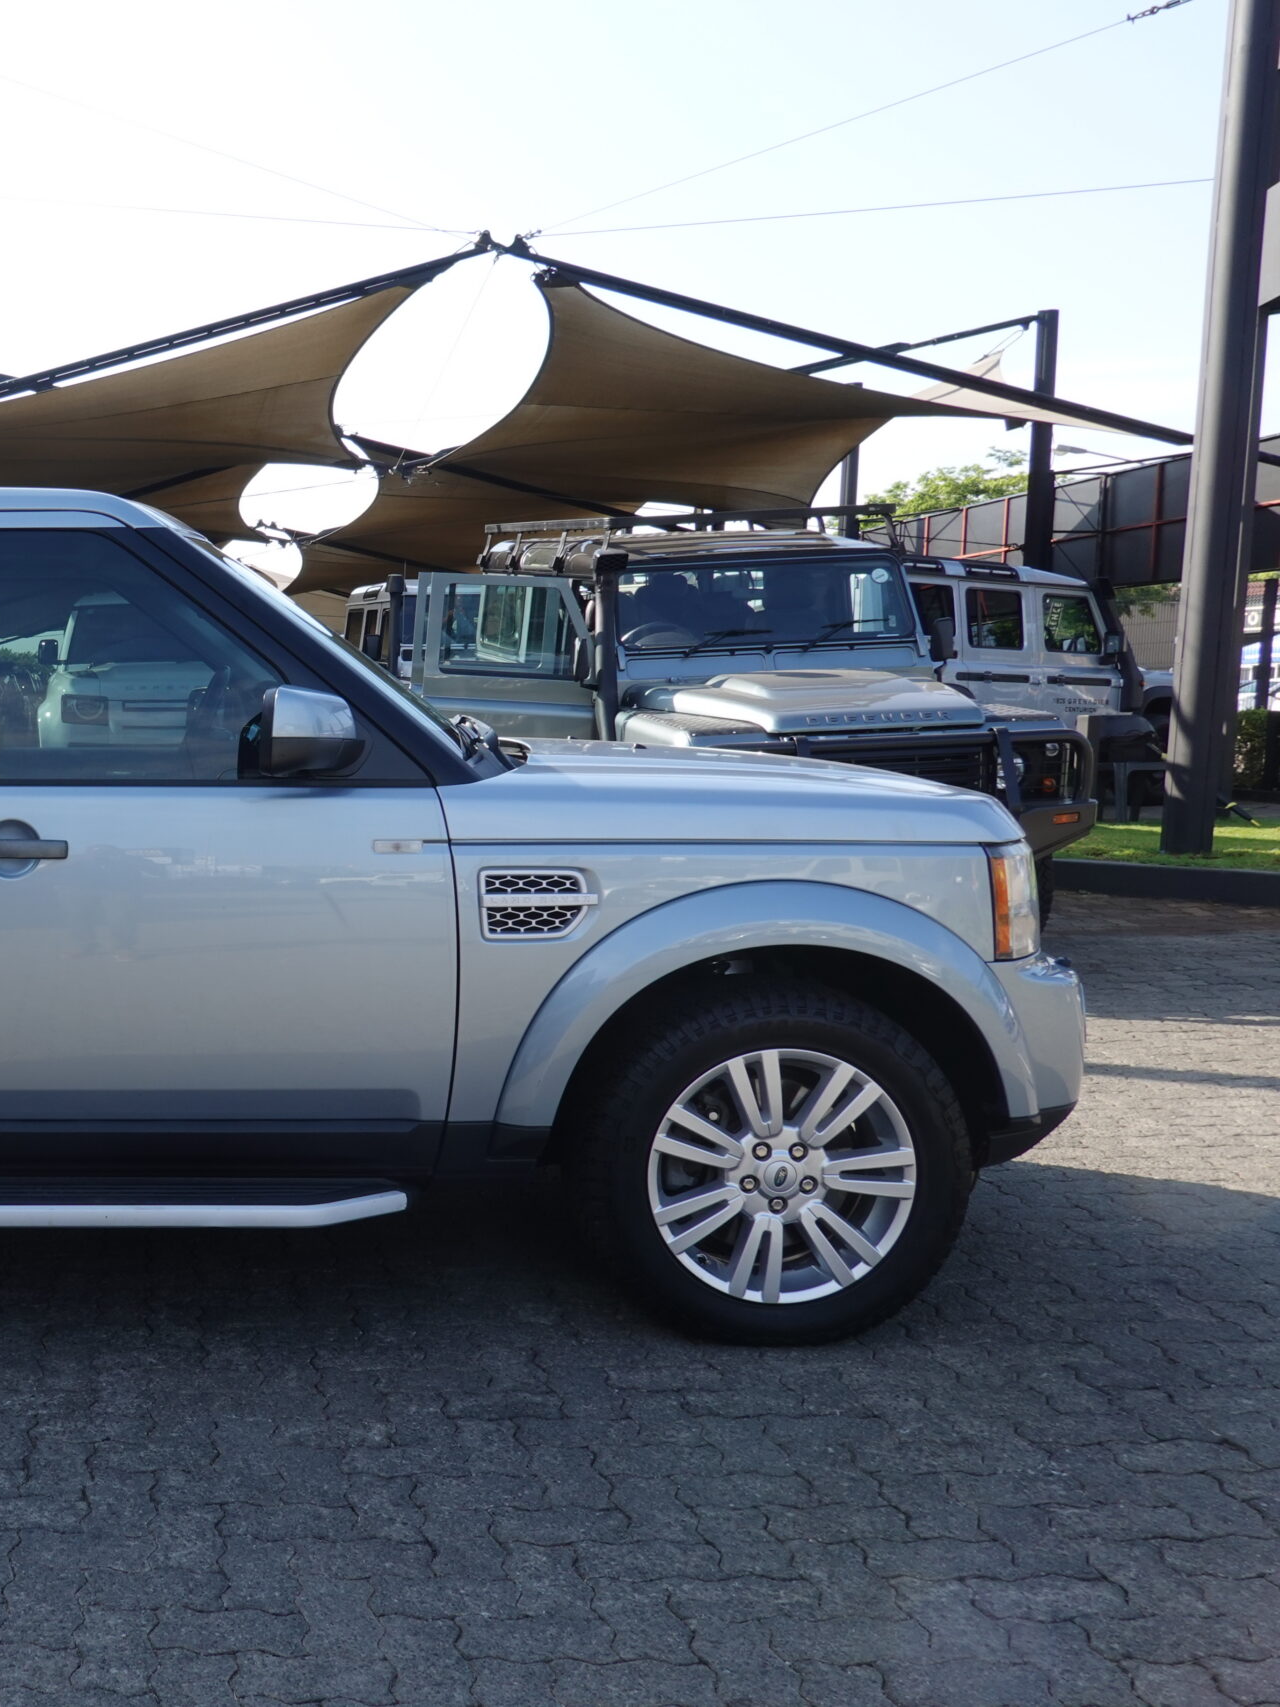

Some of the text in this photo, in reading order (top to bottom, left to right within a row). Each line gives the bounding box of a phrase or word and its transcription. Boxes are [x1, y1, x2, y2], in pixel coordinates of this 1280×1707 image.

[806, 711, 952, 727] DEFENDER
[490, 896, 591, 904] LAND ROVER
